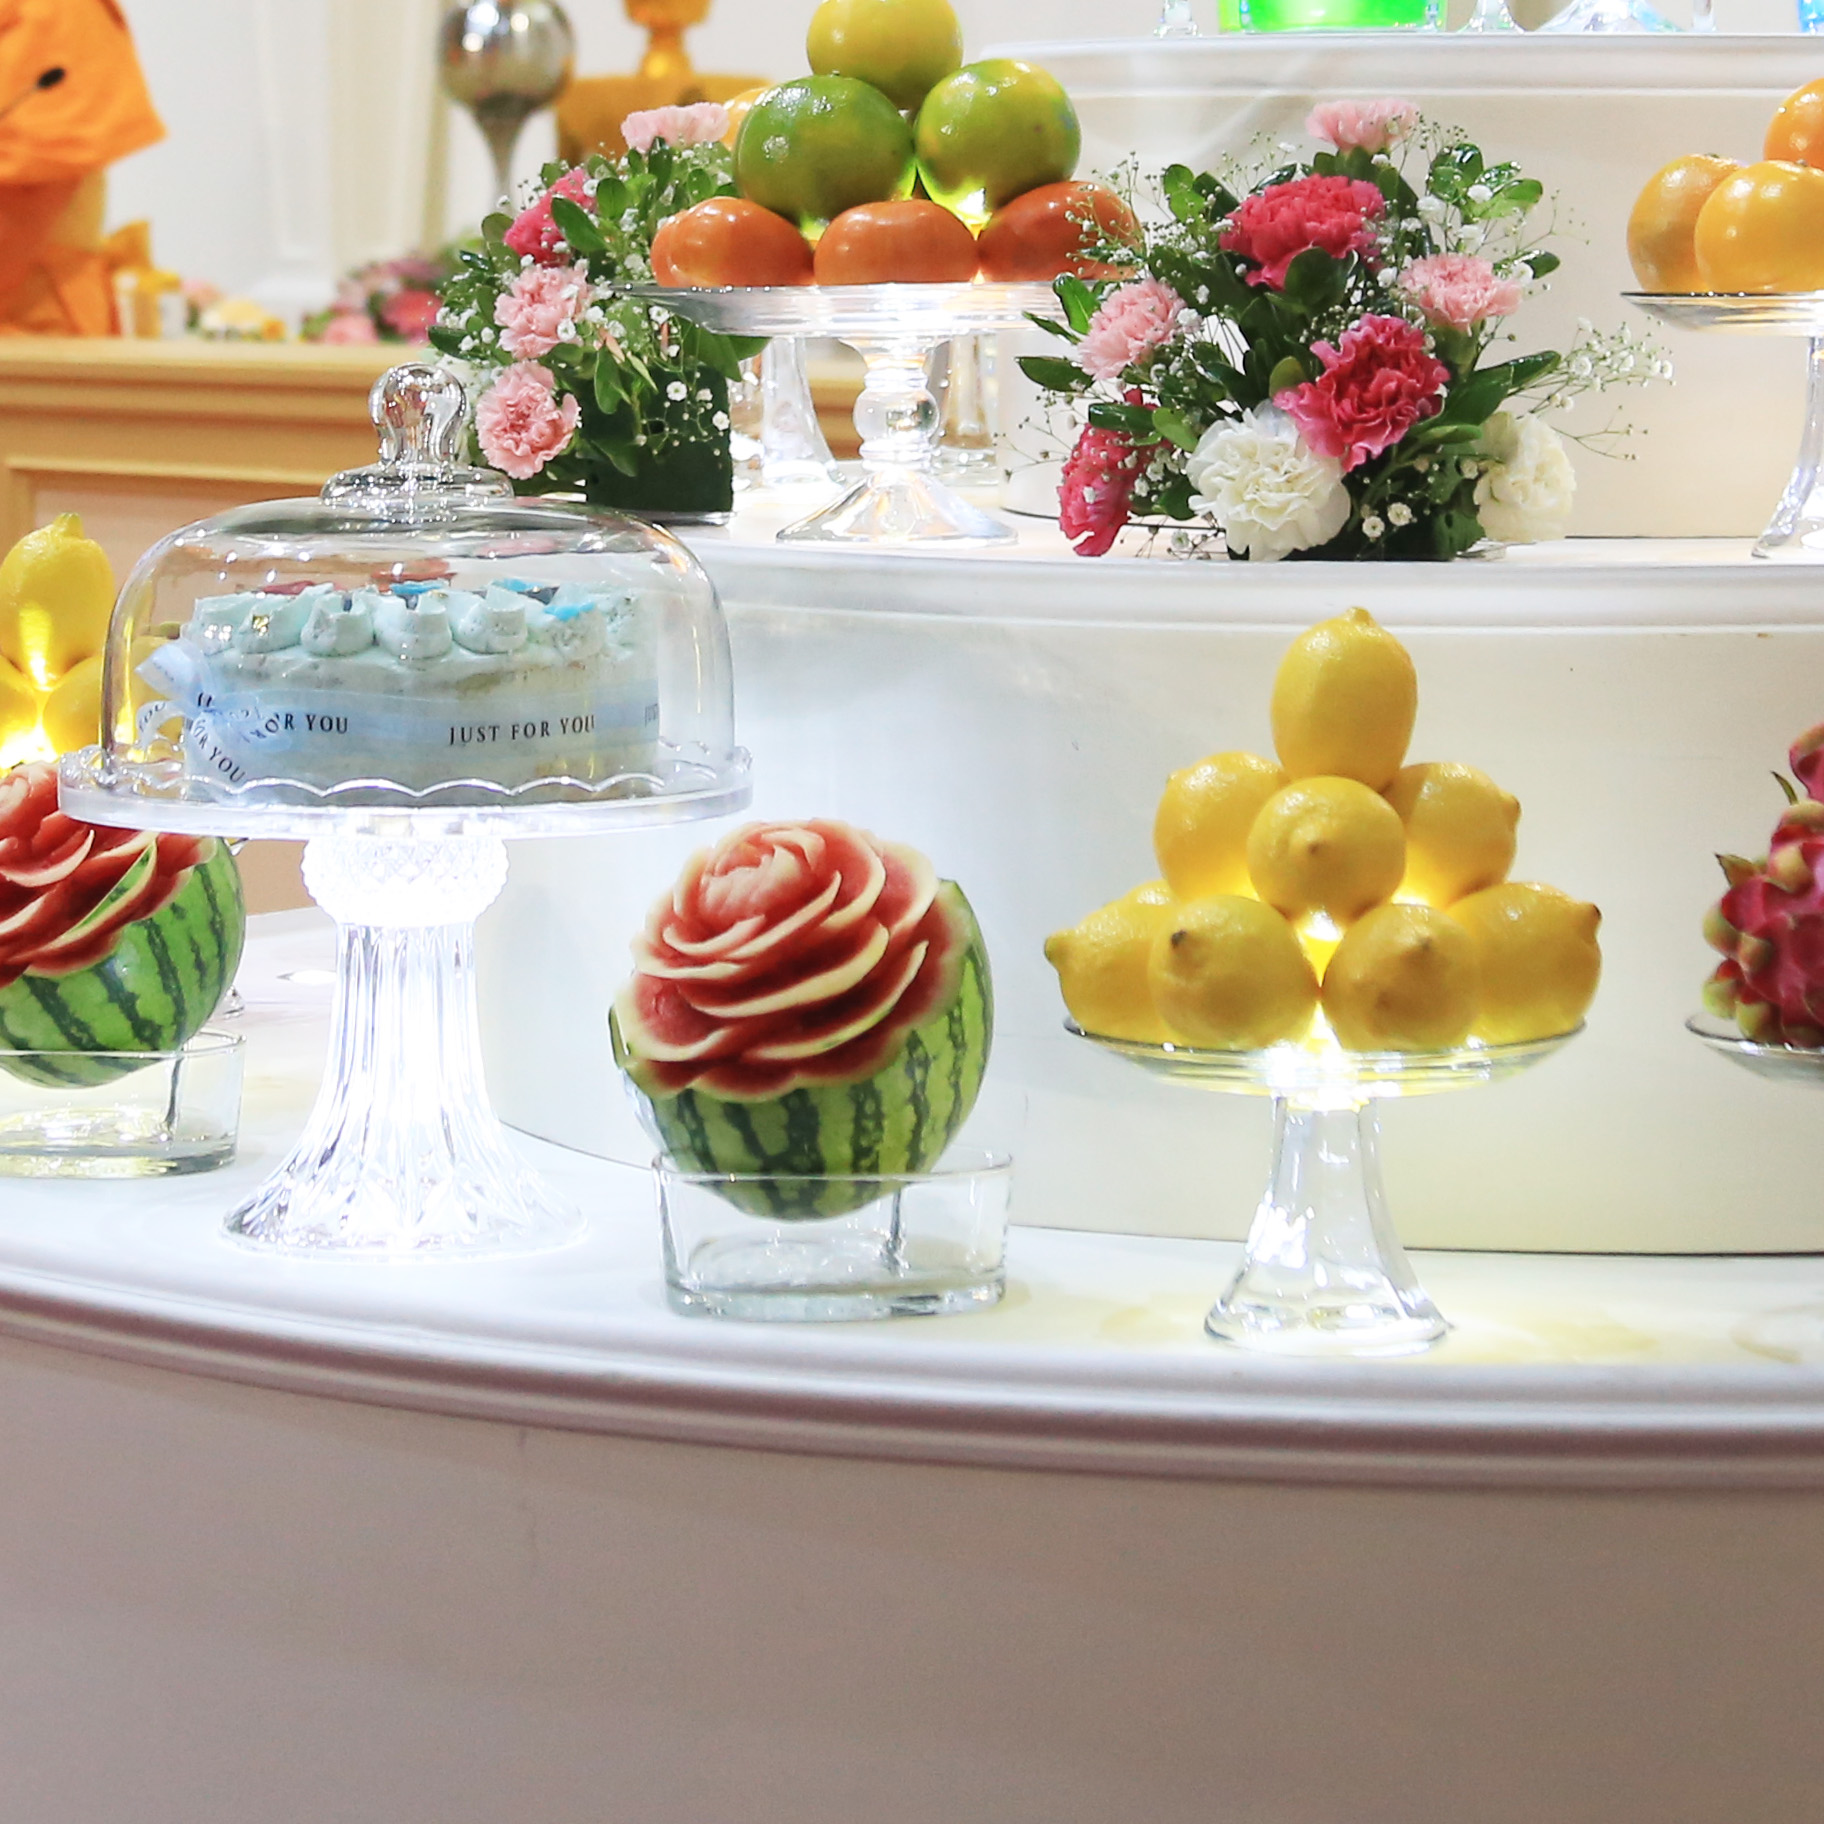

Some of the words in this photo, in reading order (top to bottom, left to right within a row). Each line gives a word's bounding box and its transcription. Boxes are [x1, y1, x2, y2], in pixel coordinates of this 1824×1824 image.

[306, 714, 349, 734] YOU
[449, 726, 501, 746] JUST
[511, 721, 551, 741] FOR
[560, 714, 595, 735] YOU
[209, 746, 247, 783] YOU
